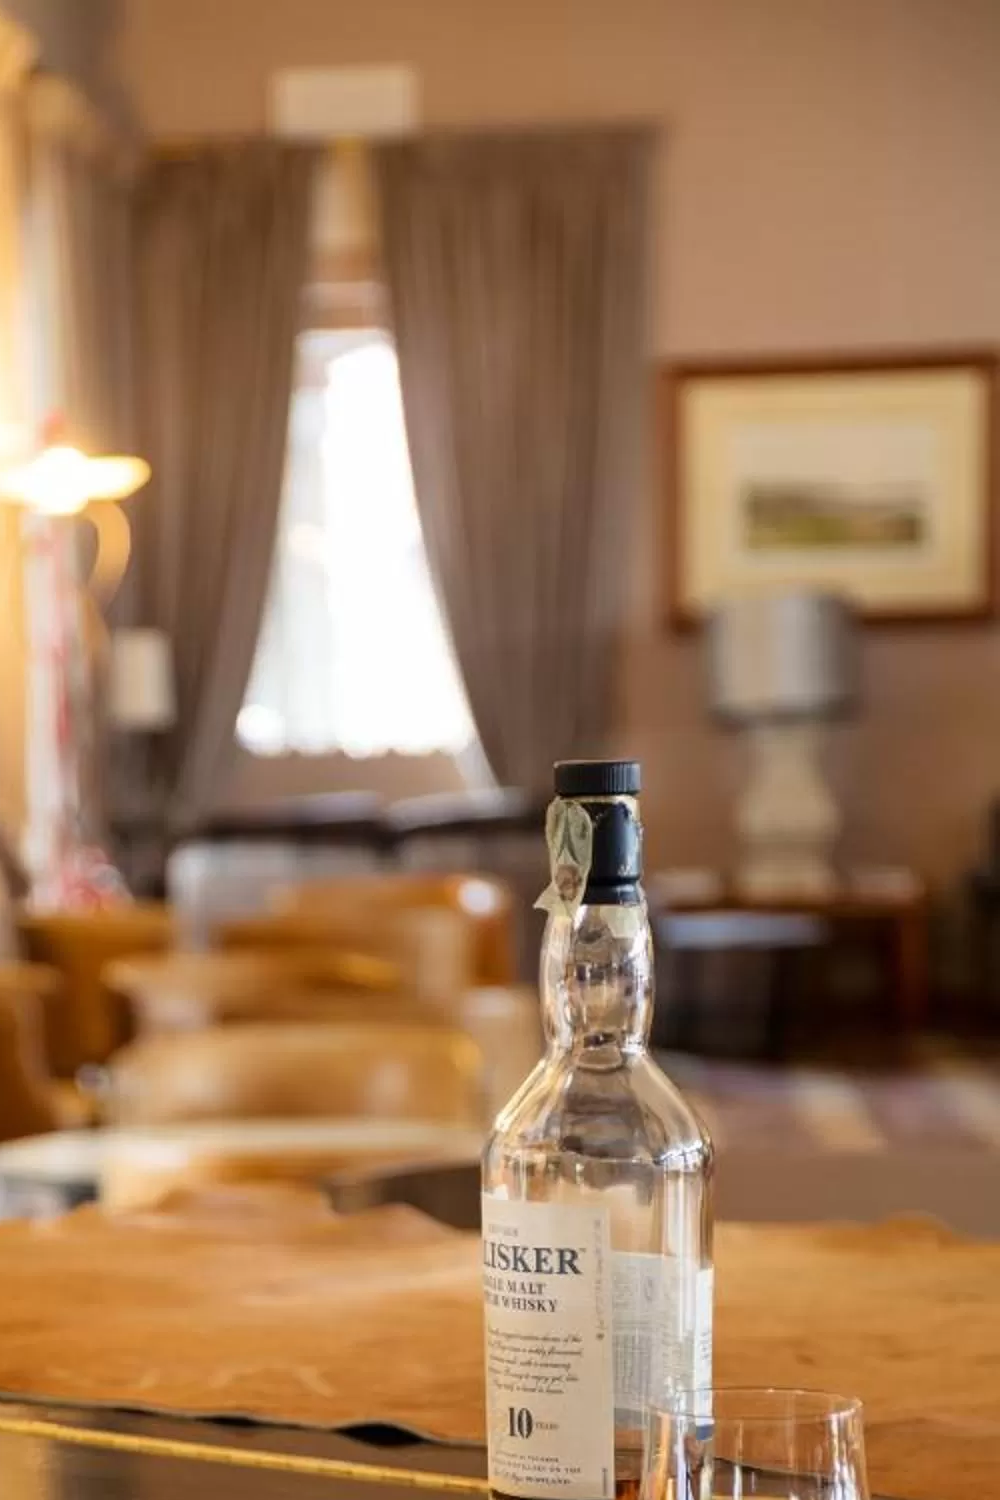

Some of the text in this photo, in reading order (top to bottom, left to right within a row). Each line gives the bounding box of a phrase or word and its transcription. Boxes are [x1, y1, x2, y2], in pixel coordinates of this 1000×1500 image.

[507, 1279, 546, 1295] MALT
[502, 1295, 557, 1313] WHISKY
[508, 1407, 533, 1439] 10
